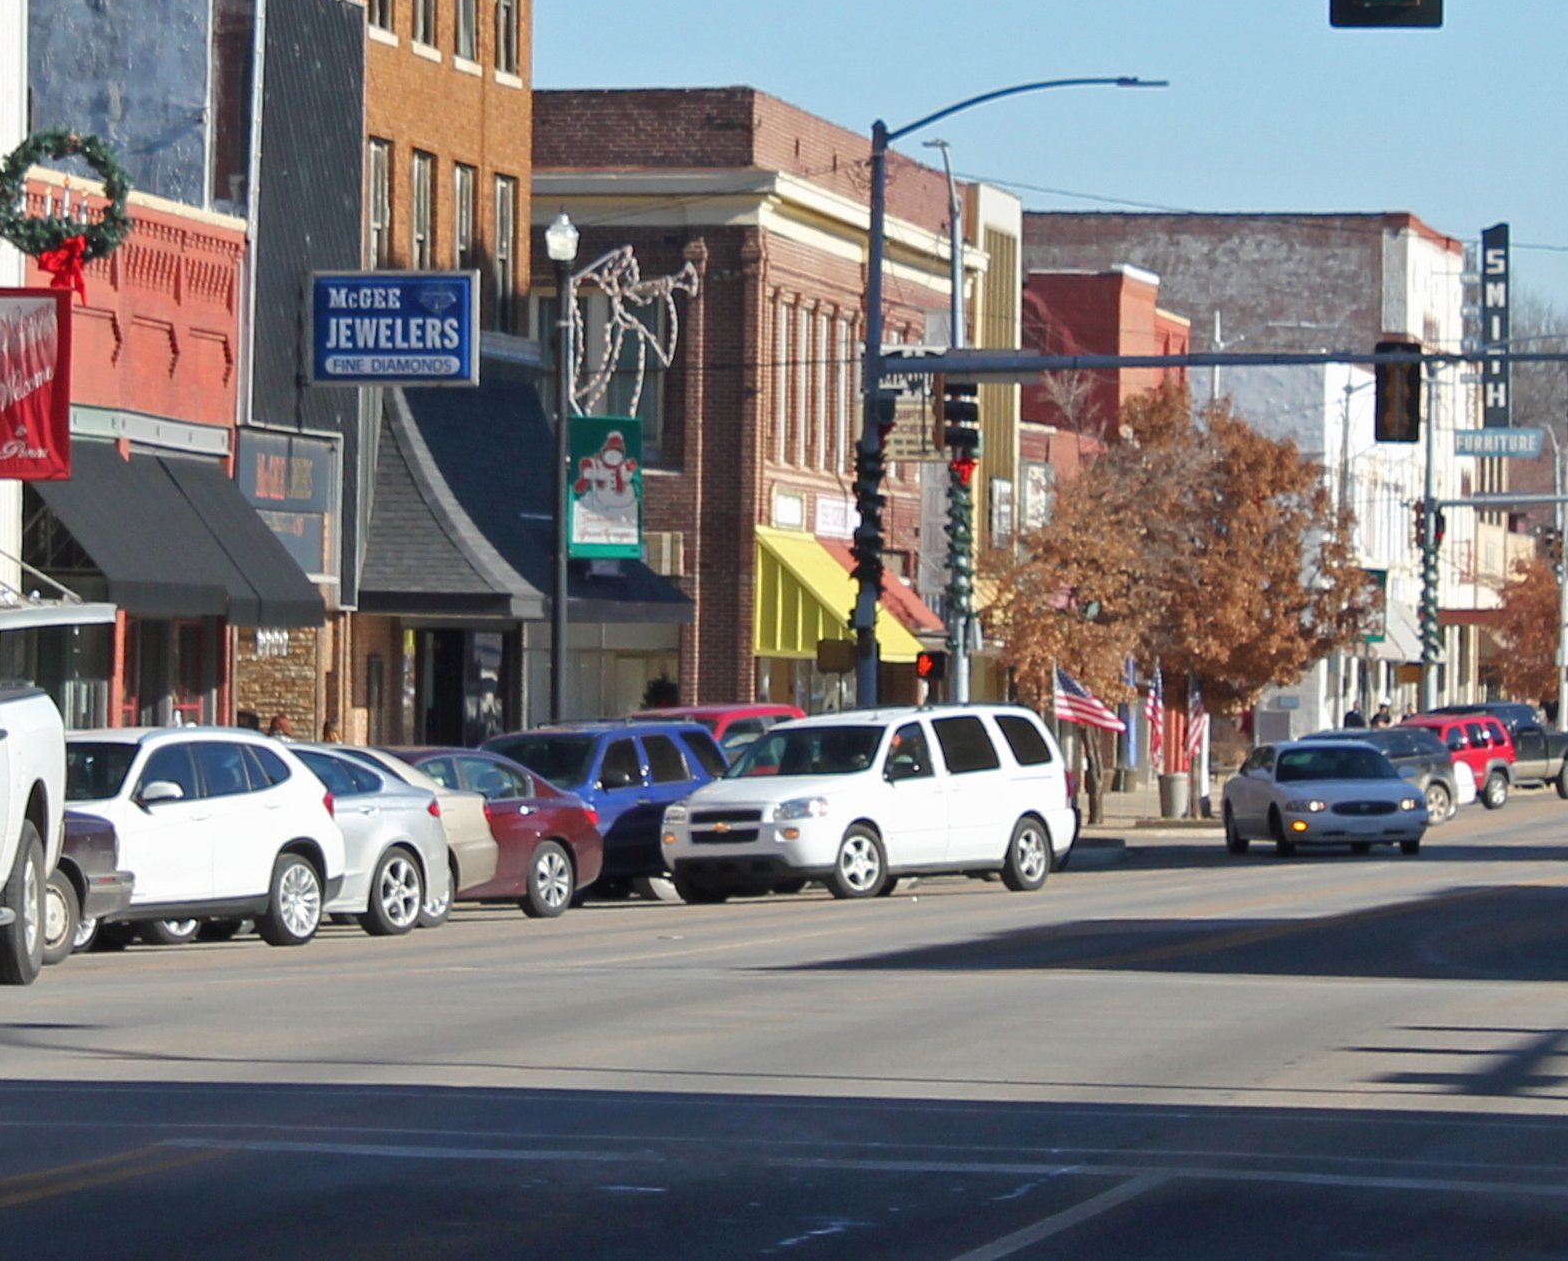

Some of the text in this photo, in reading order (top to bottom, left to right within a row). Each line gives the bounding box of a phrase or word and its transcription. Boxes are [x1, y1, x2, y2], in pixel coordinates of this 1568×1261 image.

[326, 317, 460, 350] JEWELERS
[1485, 248, 1507, 409] SMITH
[333, 358, 452, 374] FINE DIAMONDS
[1454, 432, 1537, 454] FURNITURE
